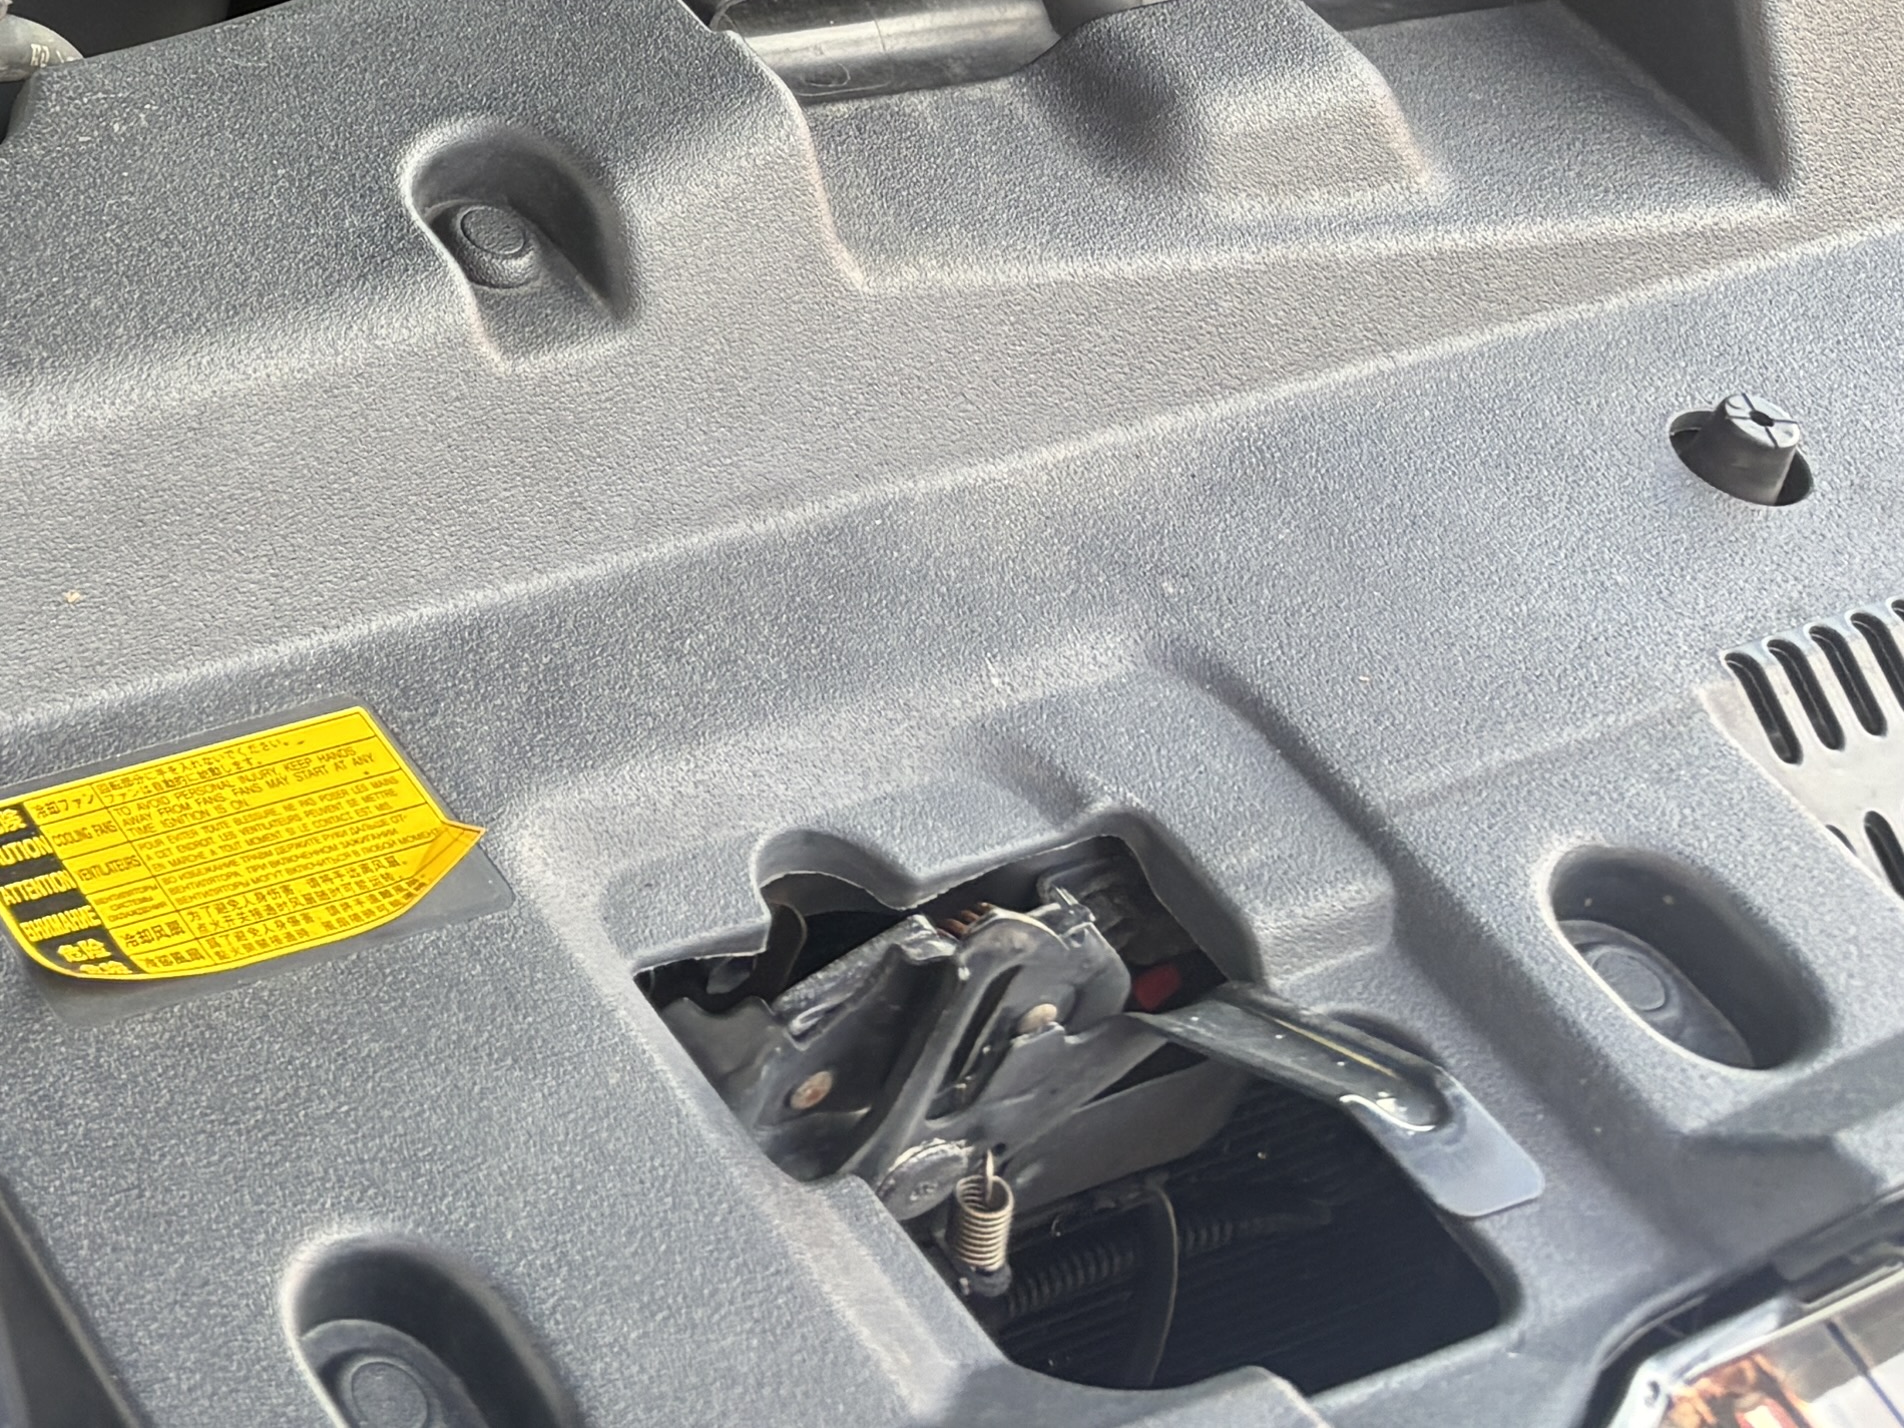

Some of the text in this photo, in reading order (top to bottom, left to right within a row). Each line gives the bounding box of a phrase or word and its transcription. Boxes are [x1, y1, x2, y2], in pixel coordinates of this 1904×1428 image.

[115, 805, 131, 817] TO
[137, 796, 170, 811] AVOID
[175, 780, 234, 801] PERSONAL
[284, 757, 313, 772] KEEP
[316, 746, 357, 763] HANDS
[122, 810, 154, 827] AWAY
[158, 800, 192, 816] FROM
[233, 782, 263, 797] FANS
[266, 775, 290, 789] MAY
[294, 766, 331, 782] START
[334, 761, 346, 772] AT
[353, 752, 375, 767] ANY
[53, 820, 119, 849] COOLING FANS
[127, 823, 156, 837] TIME
[160, 808, 210, 829] IGNITION
[215, 804, 227, 815] IS
[76, 854, 142, 882] VENTILATEURS
[21, 905, 102, 942] ВНИМАНИЕ
